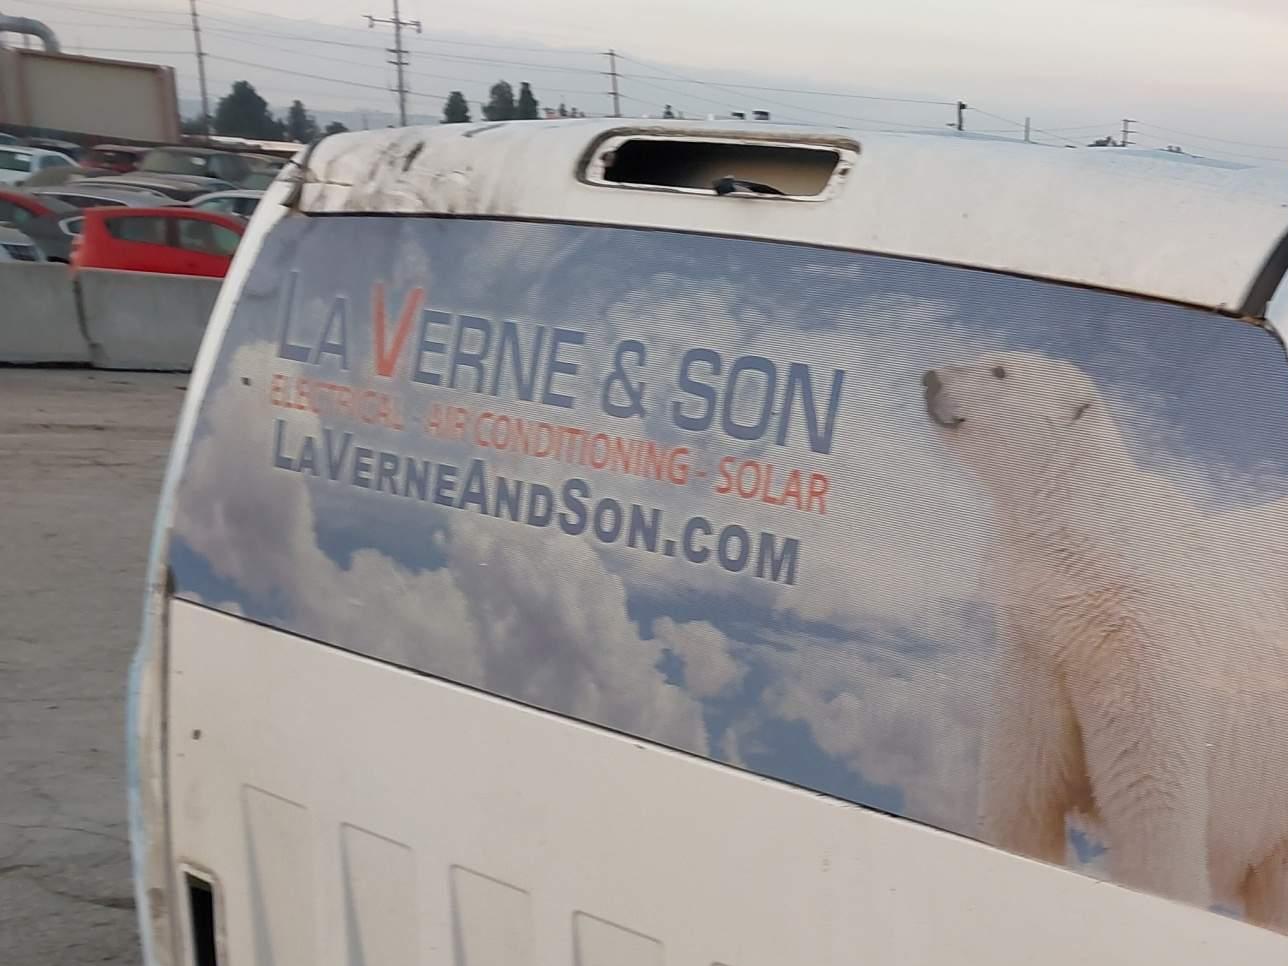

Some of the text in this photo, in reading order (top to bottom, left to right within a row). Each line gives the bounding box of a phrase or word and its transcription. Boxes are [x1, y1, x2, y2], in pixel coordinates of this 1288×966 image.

[277, 270, 846, 456] LA VERNE & SON
[474, 411, 691, 486] CONDITIONING
[716, 455, 830, 516] SOLAR
